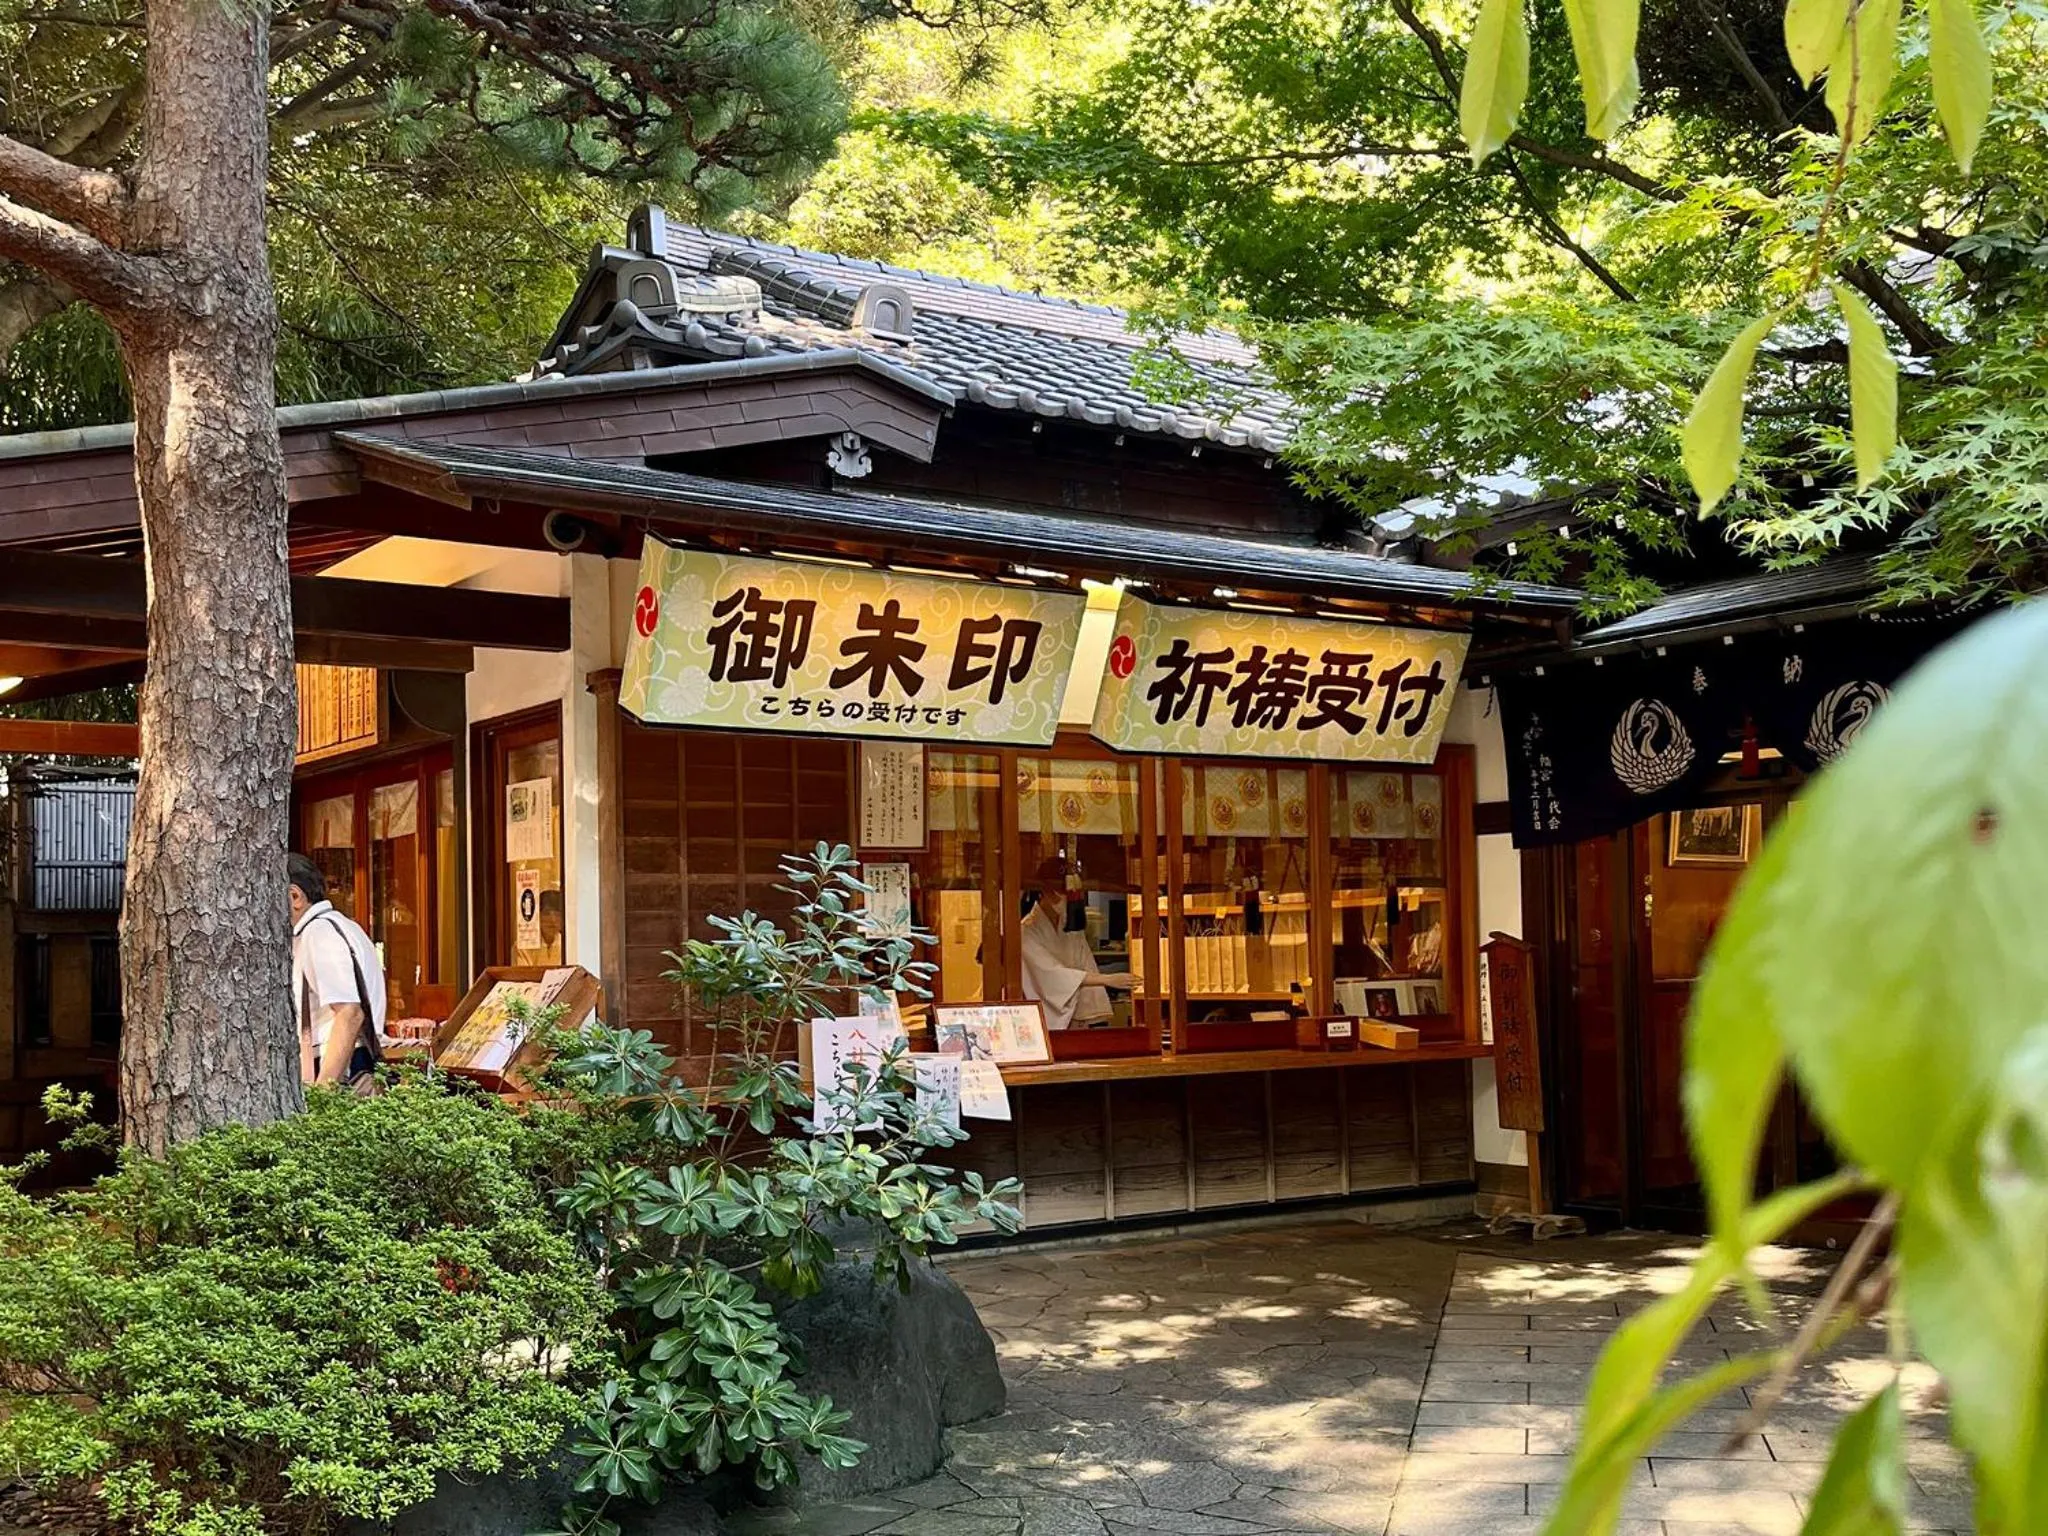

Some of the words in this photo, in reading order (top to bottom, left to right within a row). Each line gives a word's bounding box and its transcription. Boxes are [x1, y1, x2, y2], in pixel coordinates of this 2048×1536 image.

[705, 586, 1043, 705] 御朱印
[760, 696, 967, 727] こちらの受付です
